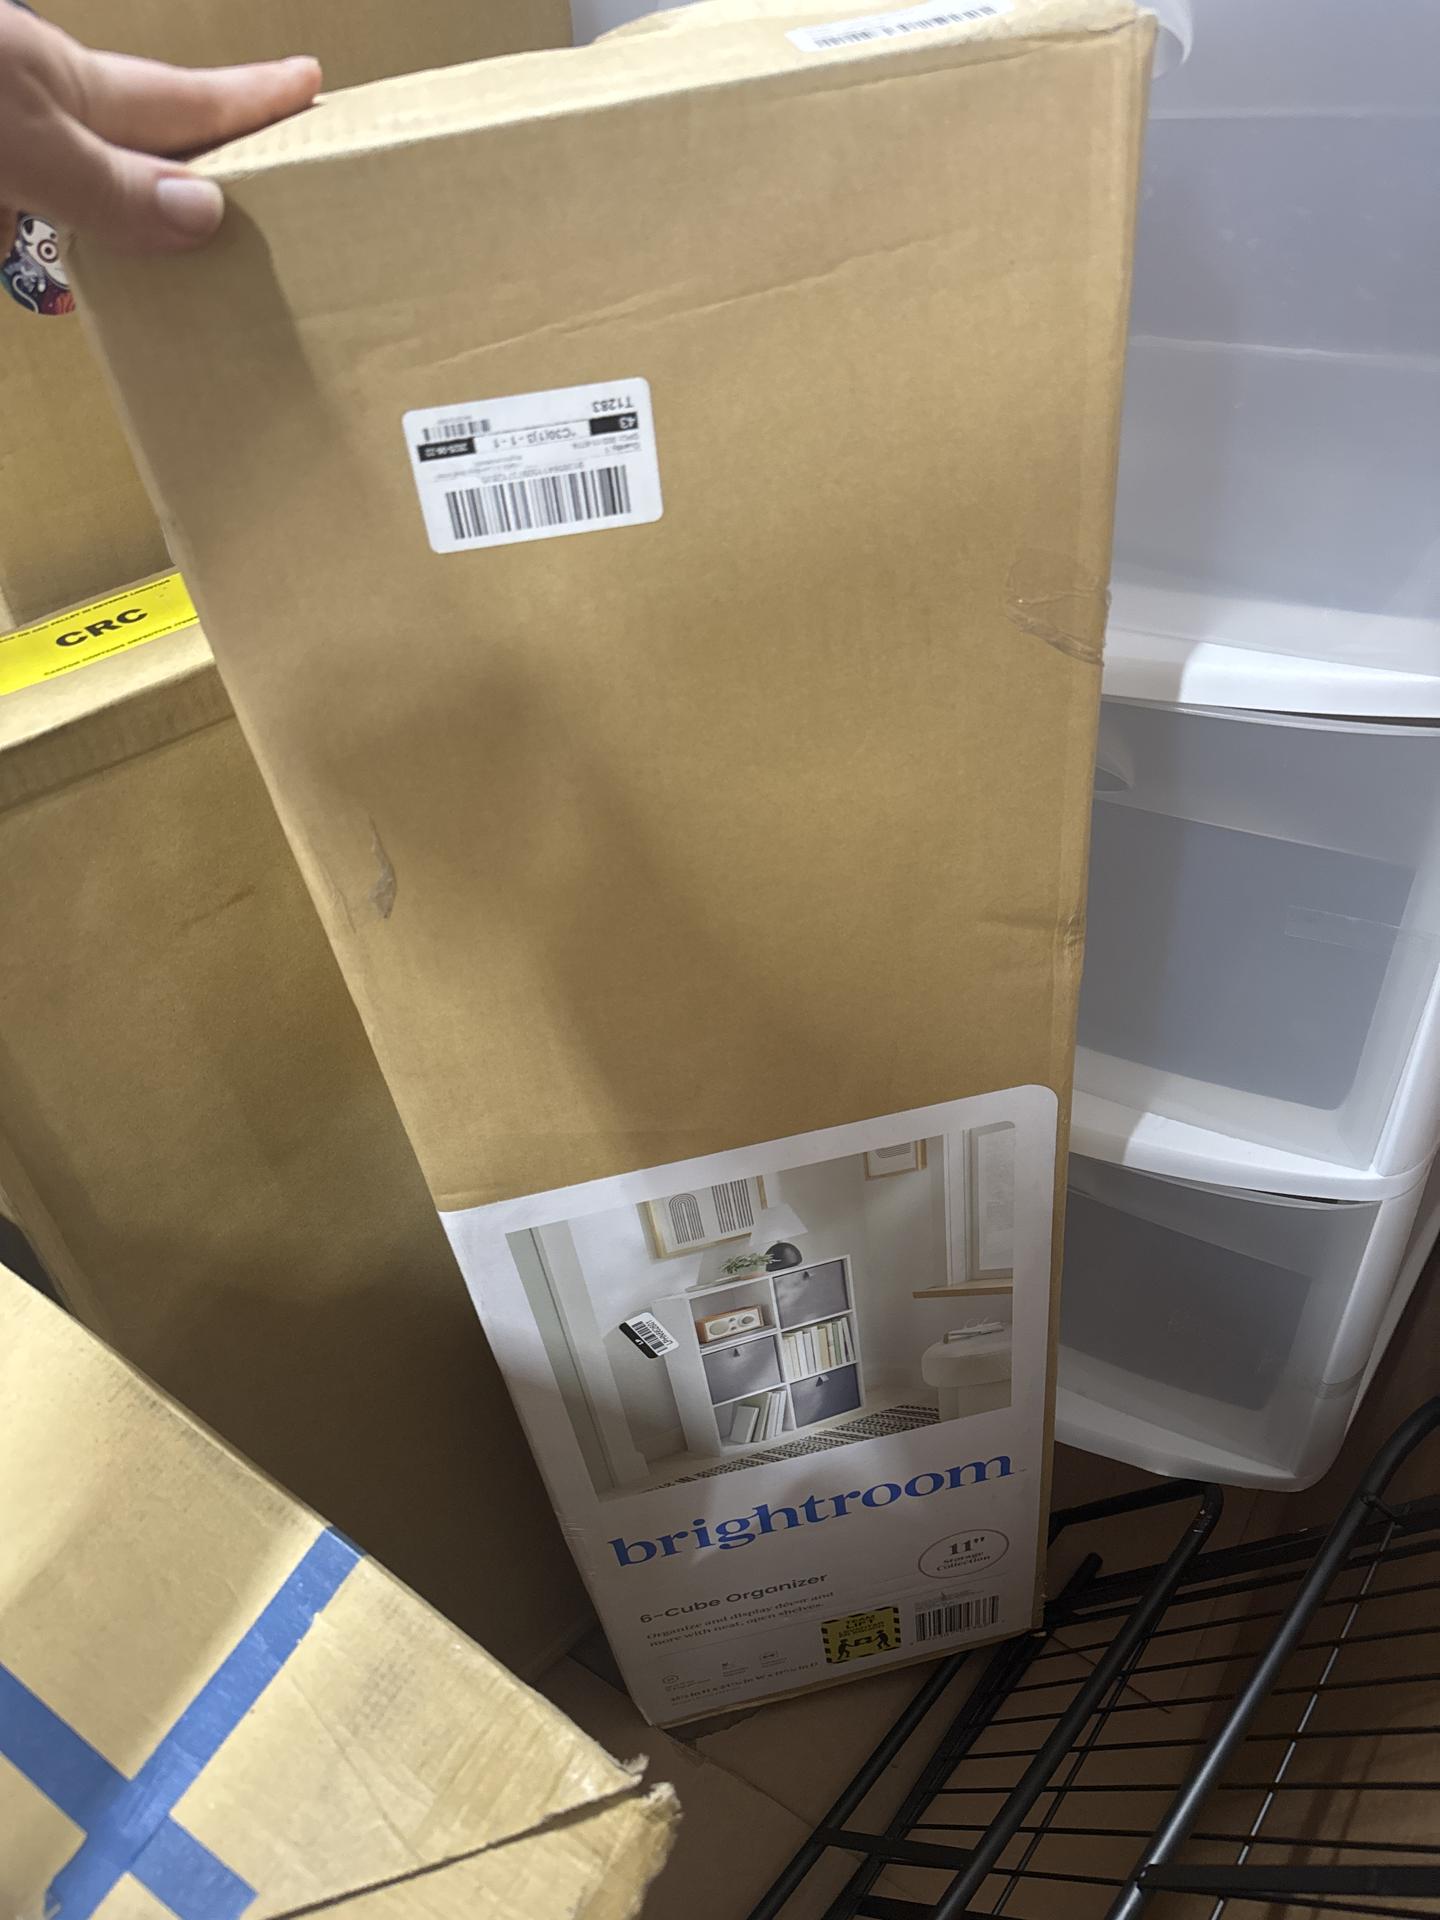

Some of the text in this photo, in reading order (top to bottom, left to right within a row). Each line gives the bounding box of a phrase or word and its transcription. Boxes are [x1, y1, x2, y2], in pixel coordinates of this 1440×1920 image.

[592, 396, 634, 413] T1283
[619, 416, 637, 430] 43
[55, 608, 148, 647] CRC
[607, 1455, 1016, 1567] brightroom
[936, 1555, 990, 1572] Collection
[640, 1573, 829, 1624] 6-Cube Organizer
[647, 1622, 702, 1641] Organize
[704, 1616, 729, 1628] and
[730, 1606, 774, 1623] display
[810, 1591, 834, 1602] and
[650, 1635, 683, 1648] more
[684, 1627, 711, 1639] with
[746, 1613, 777, 1627] open
